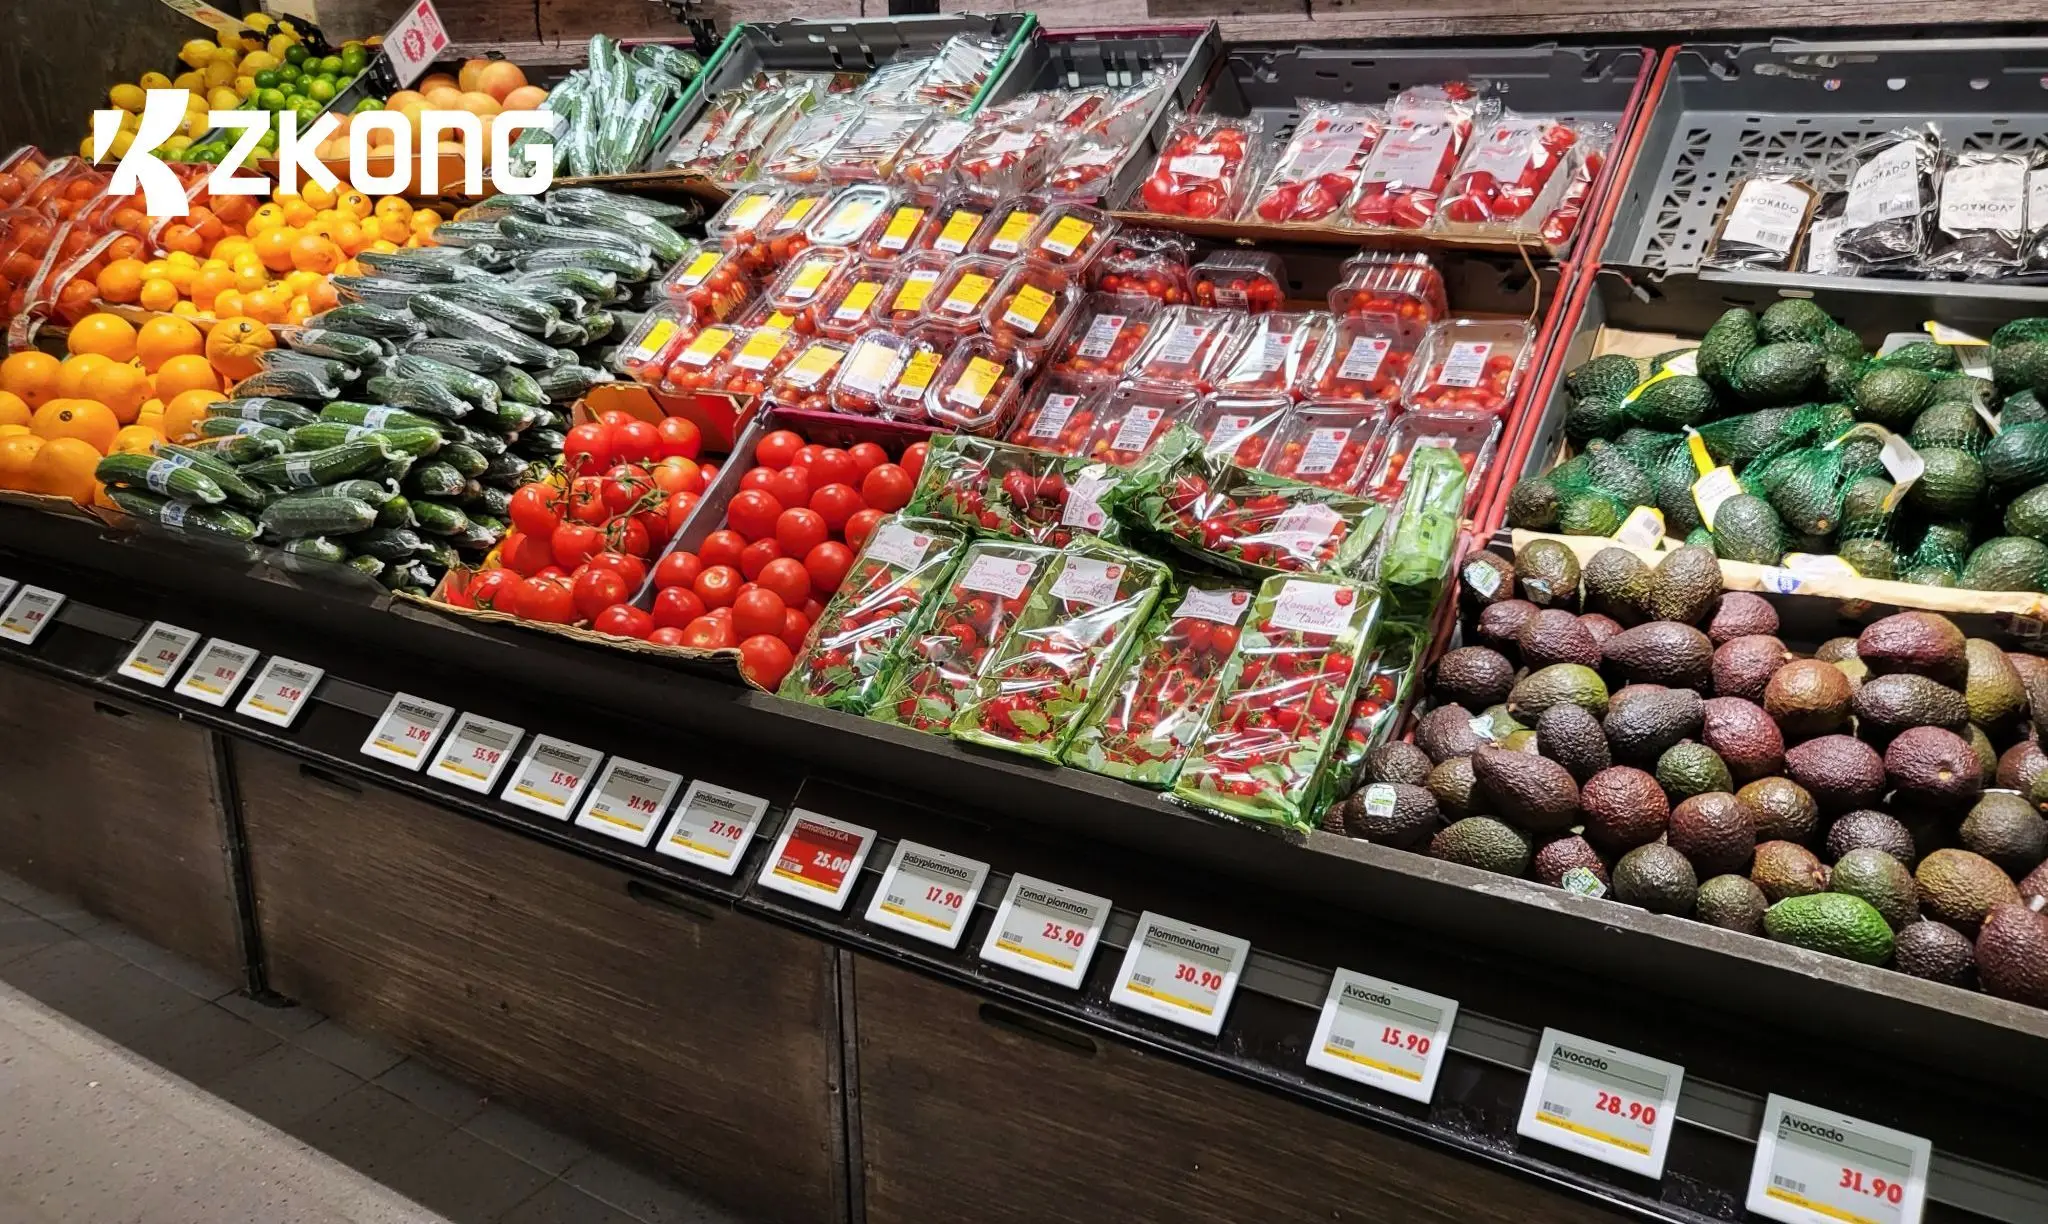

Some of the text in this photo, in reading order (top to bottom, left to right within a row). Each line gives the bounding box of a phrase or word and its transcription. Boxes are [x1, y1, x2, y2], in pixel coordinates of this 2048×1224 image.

[1744, 197, 1800, 214] AVOKADO
[1948, 203, 2016, 213] AVOKADO
[405, 726, 431, 743] 31.90
[472, 747, 500, 764] 55.90
[550, 771, 578, 788] 15.90
[627, 795, 657, 813] 31.90
[709, 820, 743, 840] 27.90
[835, 830, 849, 842] ICA
[812, 851, 850, 874] 25.00
[902, 852, 968, 879] Babyplommonto
[925, 886, 963, 909] 17.90
[1018, 887, 1088, 916] Tomat plommon
[1042, 923, 1085, 948] 25.90
[1147, 926, 1220, 955] Plommontomat
[1175, 964, 1222, 990] 30.90
[1343, 984, 1391, 1006] Avocado
[1381, 1027, 1430, 1054] 15.90
[1553, 1046, 1608, 1071] Avocado
[1595, 1092, 1656, 1125] 28.90
[1780, 1114, 1844, 1143] Avocado
[1839, 1168, 1904, 1204] 31.90
